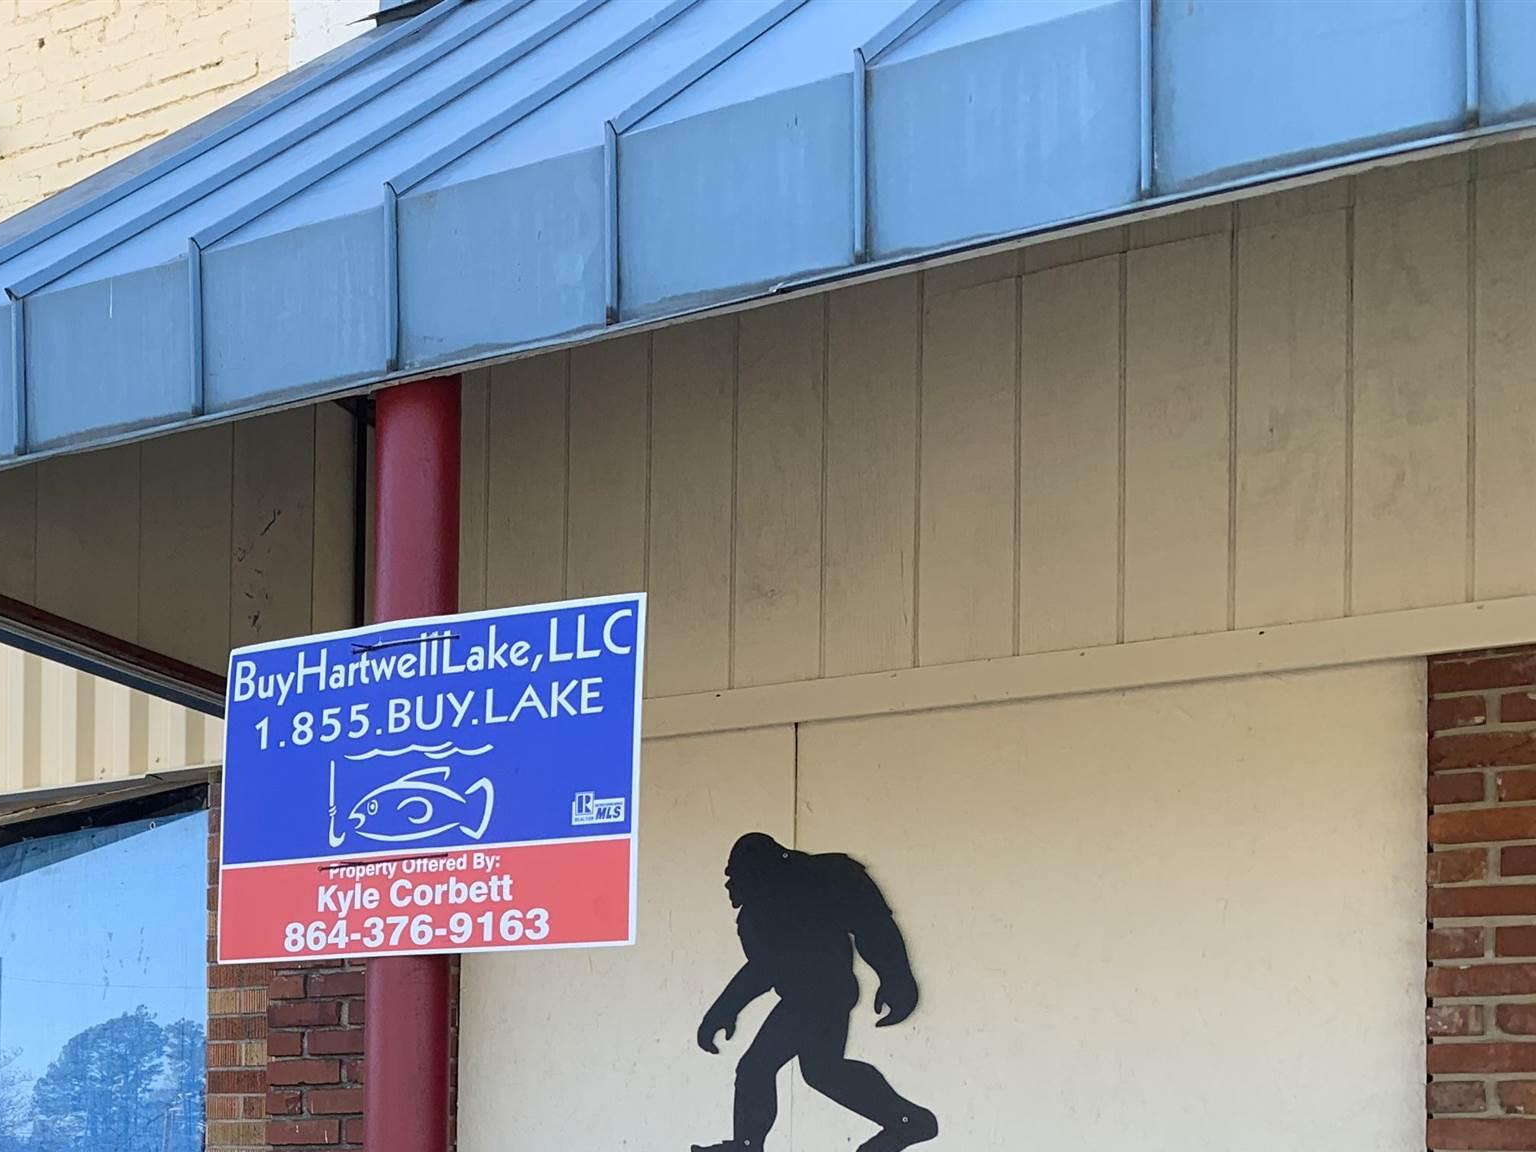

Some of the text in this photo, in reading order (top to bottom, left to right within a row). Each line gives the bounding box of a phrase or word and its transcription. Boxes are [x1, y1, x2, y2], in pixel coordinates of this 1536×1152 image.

[255, 676, 604, 751] 1.855.BUY.LAKE
[595, 806, 621, 820] MLS
[328, 852, 501, 882] Property Offered By:
[317, 873, 514, 918] Kyle Corbett
[283, 907, 551, 953] 864-376-9163
